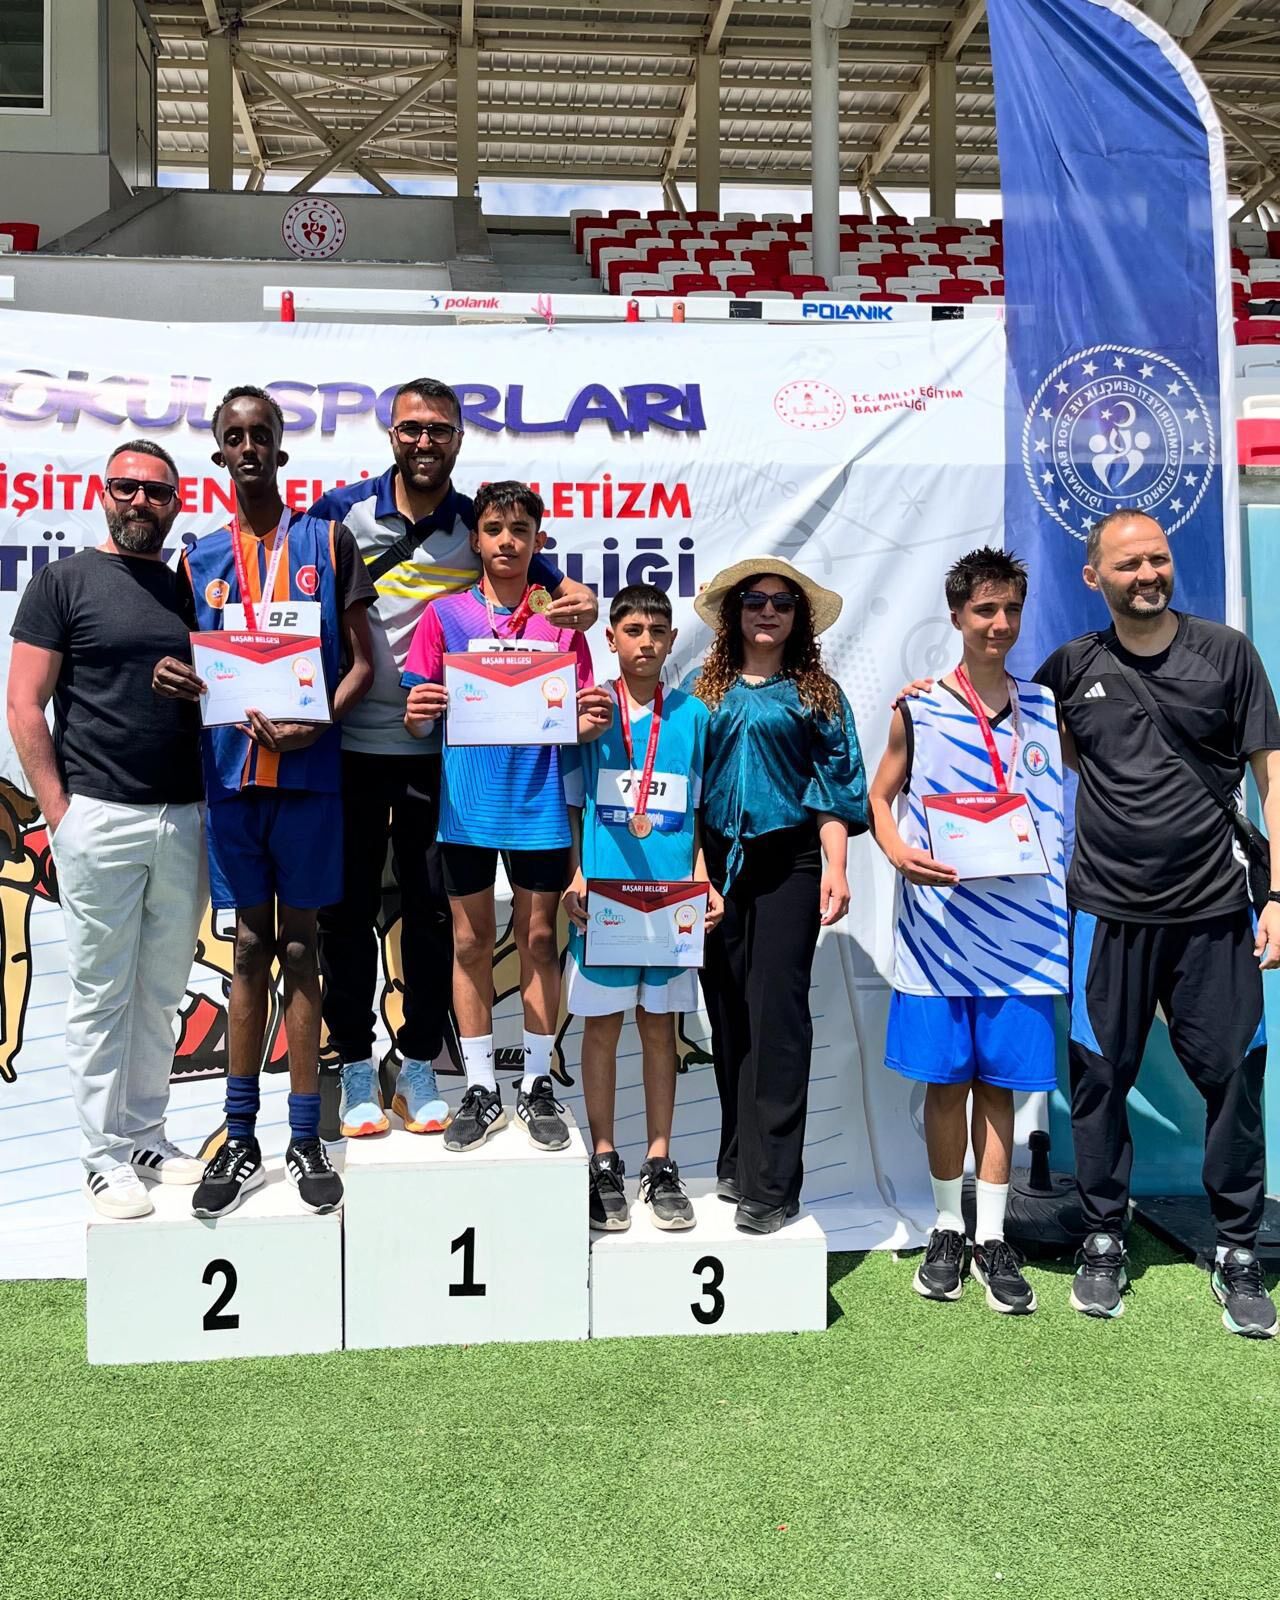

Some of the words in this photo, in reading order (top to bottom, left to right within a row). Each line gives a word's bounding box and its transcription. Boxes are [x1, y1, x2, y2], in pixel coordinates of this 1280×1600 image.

[802, 303, 893, 321] POLANIK
[853, 399, 927, 414] BAKANLIĞI
[202, 1259, 240, 1331] 2
[449, 1227, 486, 1297] 1
[690, 1256, 725, 1325] 3
